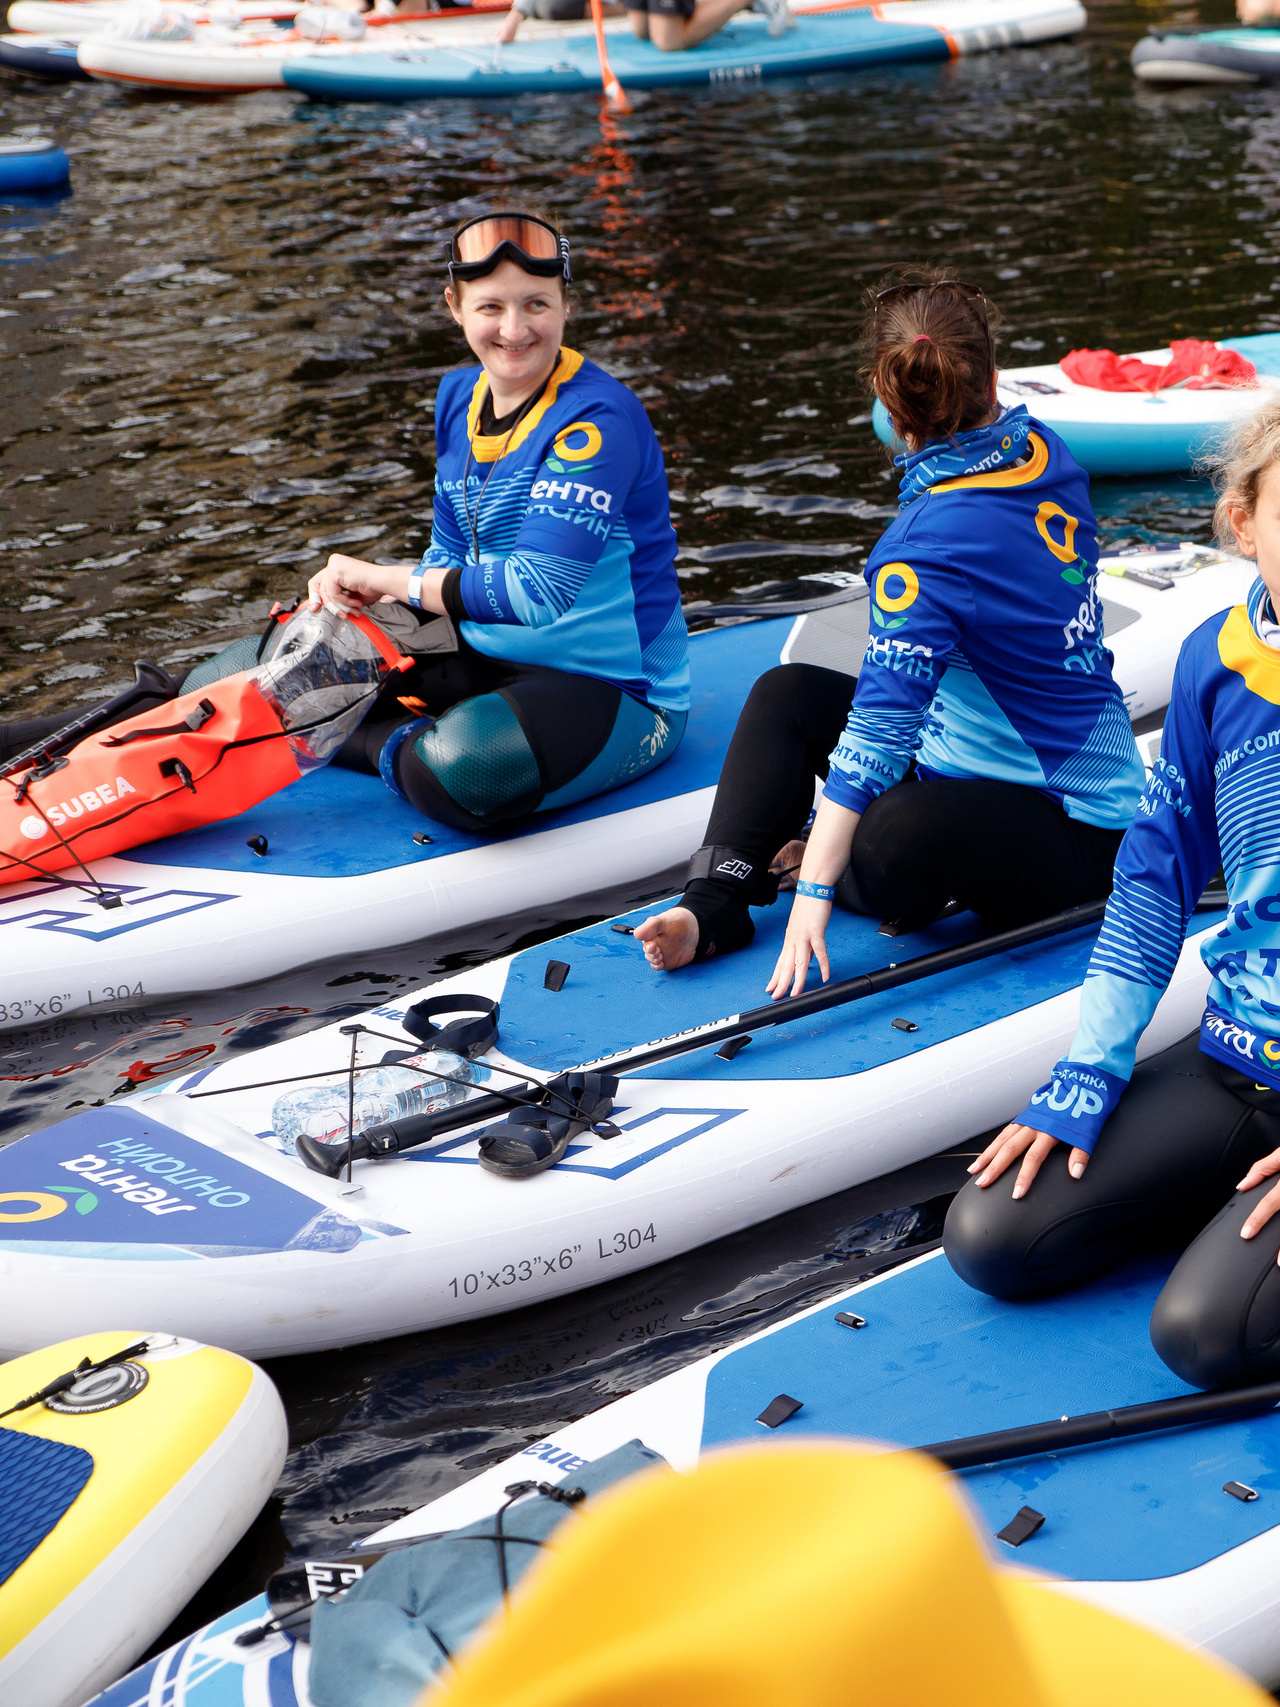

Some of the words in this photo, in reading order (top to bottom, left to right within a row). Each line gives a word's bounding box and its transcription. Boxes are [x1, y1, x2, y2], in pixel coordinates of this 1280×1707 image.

[530, 479, 613, 514] ента
[833, 744, 895, 780] НТАНКА
[46, 776, 136, 826] SUBEA
[58, 1154, 197, 1216] лента
[96, 1137, 250, 1208] онлайн
[598, 1222, 657, 1259] L304
